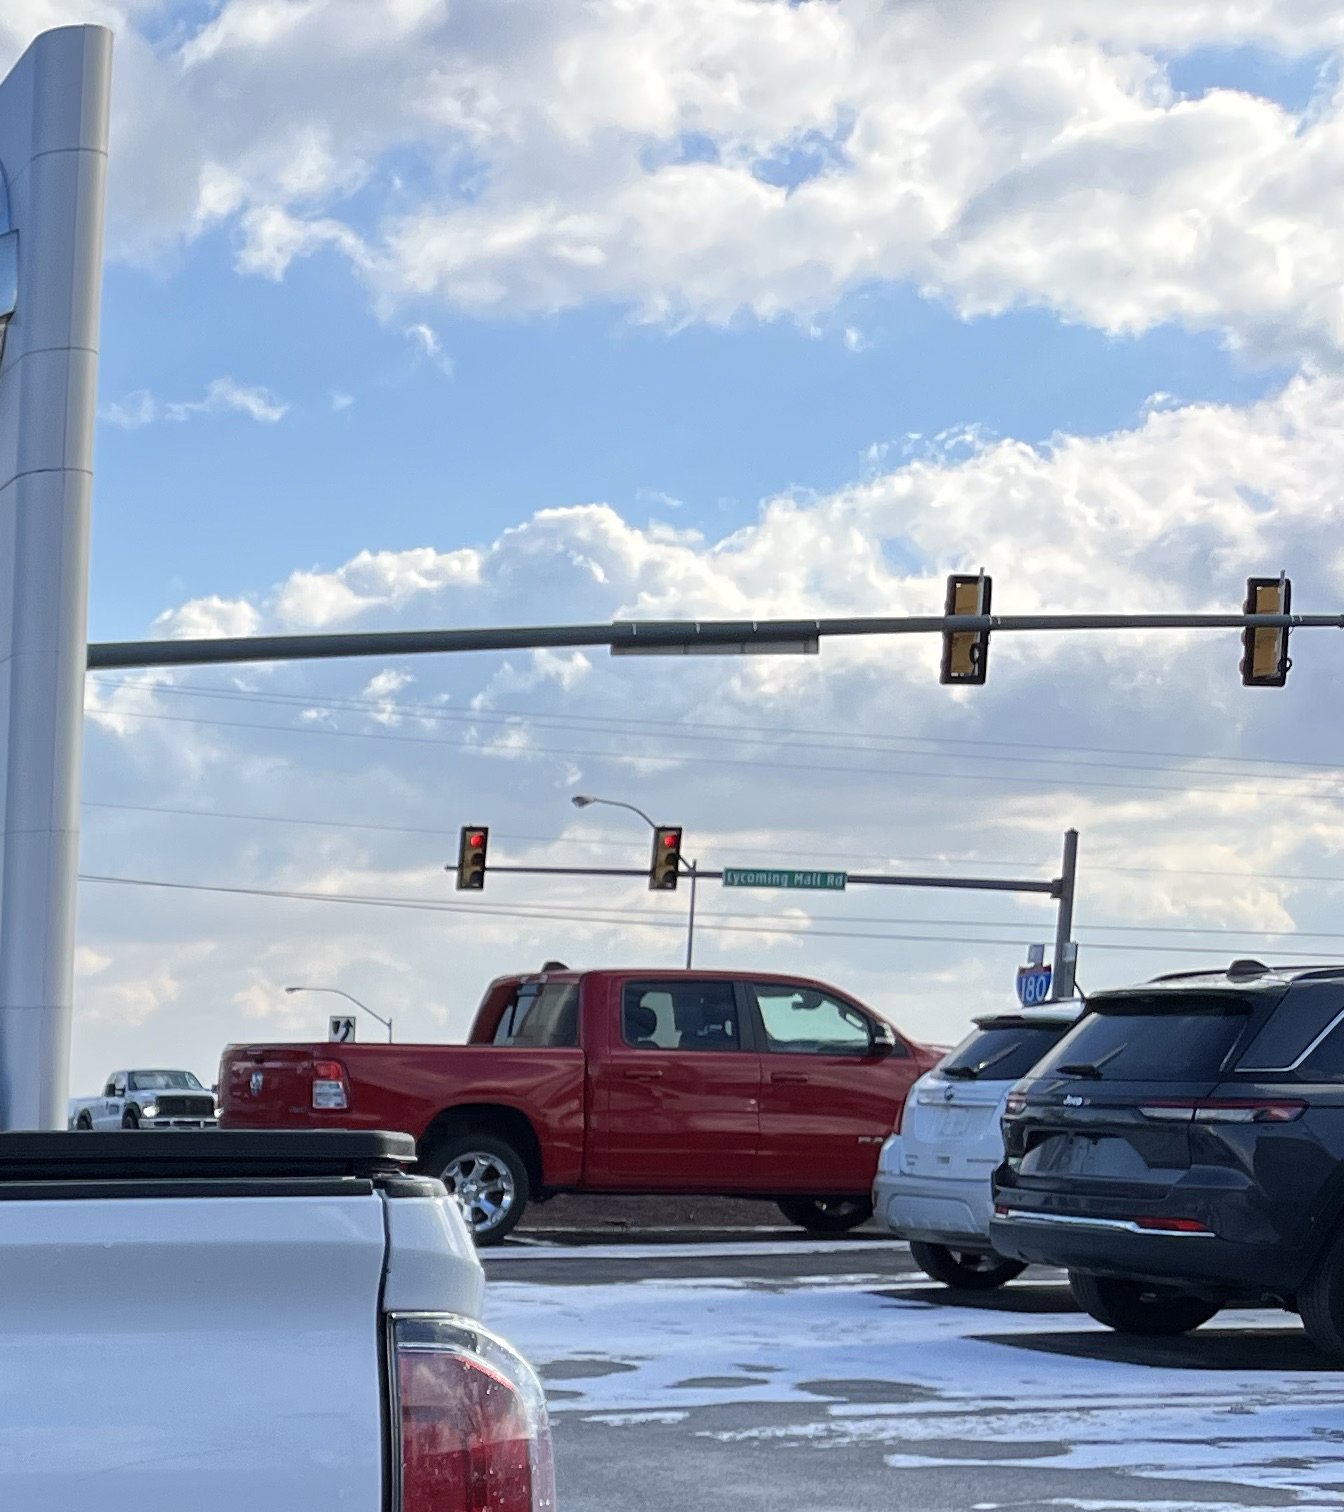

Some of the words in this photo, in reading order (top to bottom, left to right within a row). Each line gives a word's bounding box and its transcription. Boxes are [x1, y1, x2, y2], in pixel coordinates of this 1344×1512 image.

[727, 869, 788, 887] Lycoming
[794, 872, 821, 887] Mall
[826, 873, 844, 888] Rd
